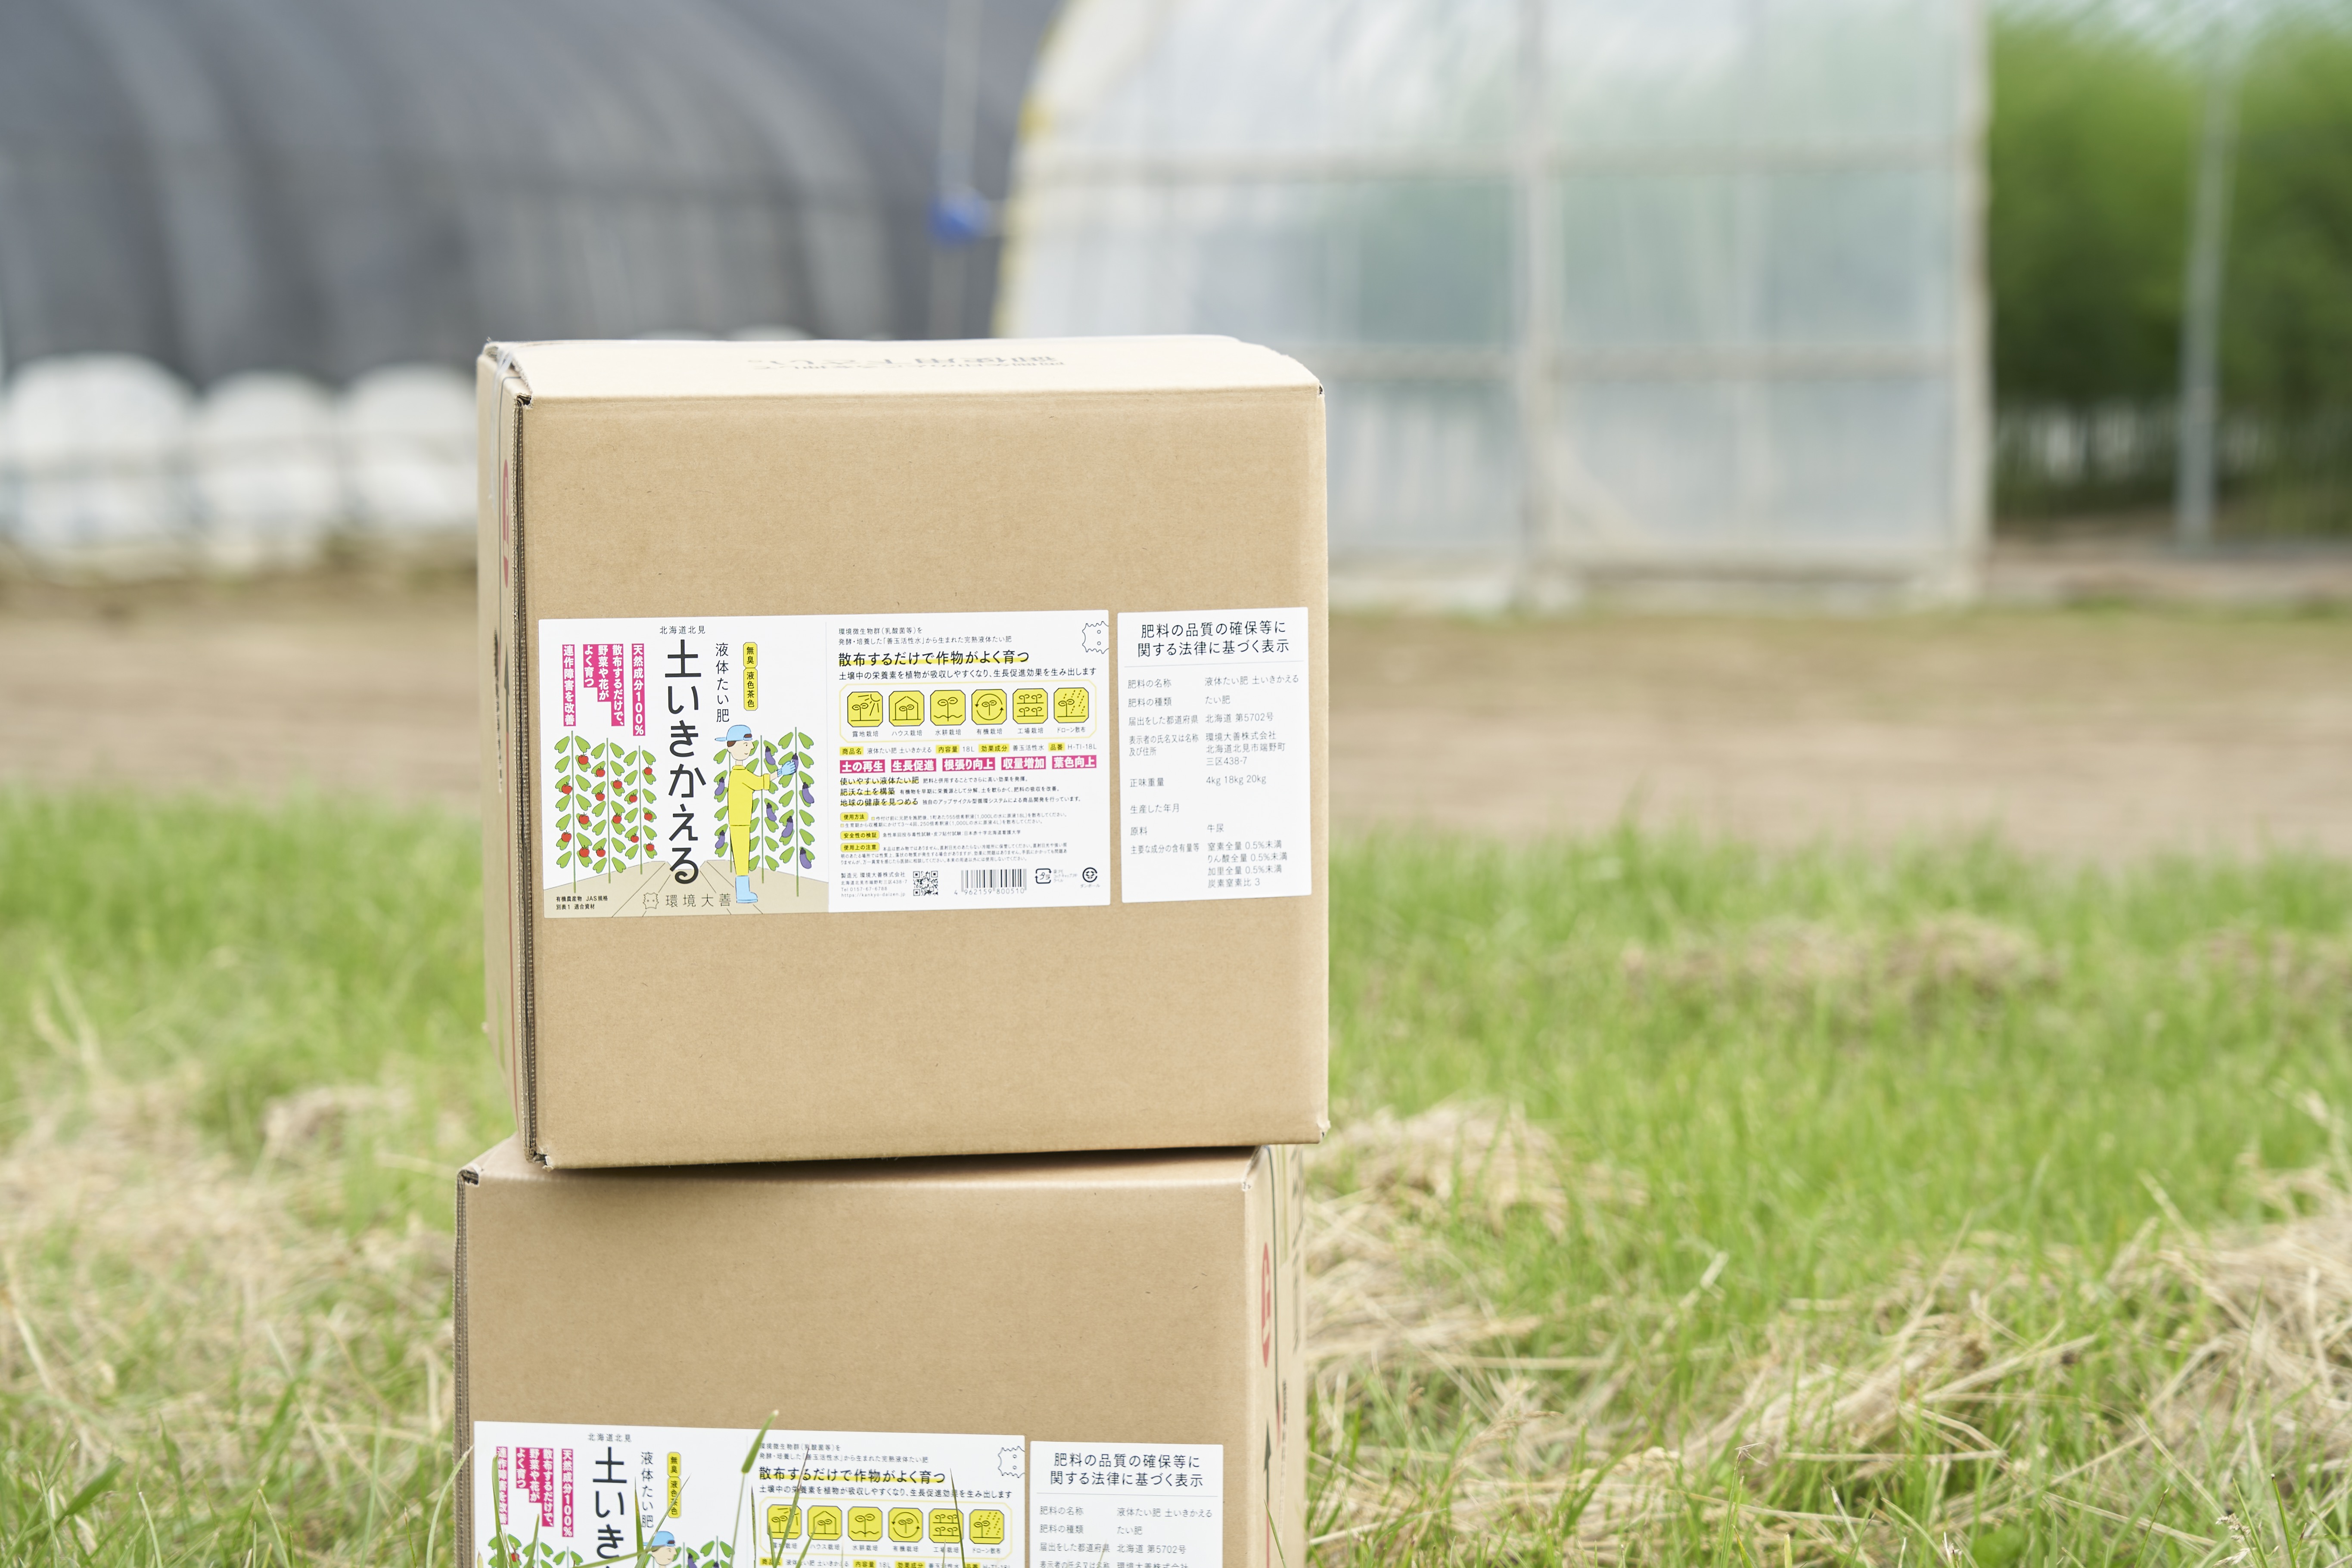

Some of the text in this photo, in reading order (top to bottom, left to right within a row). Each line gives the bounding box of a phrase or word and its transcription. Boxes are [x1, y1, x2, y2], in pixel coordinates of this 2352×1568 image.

[659, 625, 705, 635] 北海道北見
[1141, 621, 1286, 639] 肥料の品質の確保等に
[1138, 639, 1289, 657] 関する法律に基づく表示
[747, 646, 754, 664] 無臭
[839, 650, 1029, 667] 散布するだけで作物がよく育つ
[584, 645, 594, 686] よく育つ
[598, 645, 609, 701] 野菜や花が
[563, 645, 575, 725] 連作障害を改善
[612, 645, 624, 726] 散布するだけで、
[716, 643, 729, 722] 液体たい肥
[1128, 678, 1171, 689] 肥料の名称
[1205, 675, 1299, 686] 液体たい肥 土いきかえる
[633, 645, 643, 735] 天然成分100%
[1128, 697, 1171, 707] 肥料の種類
[1205, 695, 1230, 705] たい肥
[1129, 715, 1198, 726] 届出をした都道府県
[1206, 712, 1274, 723] 北海道 第5702号
[1129, 733, 1199, 745] 表示者の氏名又は名称
[1206, 731, 1276, 742] 環境大善株式会社
[1129, 747, 1156, 757] 及び住所
[1206, 742, 1285, 754] 北海道北見市端野町
[665, 639, 706, 884] 土いきかえる
[842, 761, 883, 772] 土の再生
[892, 760, 934, 771] 生長促進
[944, 758, 993, 770] 根張り向上
[1003, 758, 1044, 769] 収量増加
[1053, 757, 1095, 768] 葉色向上
[1206, 757, 1247, 766] 三区438-7
[840, 776, 919, 785] 使いやすい液体たい肥
[1130, 778, 1164, 788] 正味重量
[1206, 775, 1266, 786] 4kg 18kg 20kg
[840, 787, 895, 796] 肥沃な土を構築
[840, 798, 918, 807] 地球の健康を見つめる
[1131, 804, 1179, 814] 生産した年月
[1131, 826, 1147, 836] 原料
[1207, 823, 1224, 833] 牛尿
[1131, 843, 1199, 854] 主要な成分の含有量等
[1208, 840, 1282, 851] 窒素全量 0.5%未満
[1208, 852, 1287, 863] りん酸全量 0.5%未満
[1208, 865, 1282, 876] 加里全量 0.5%未満
[1208, 879, 1251, 888] 炭素窒素比
[666, 893, 731, 907] 環境大善
[588, 1433, 631, 1442] 北海道北見
[1054, 1452, 1200, 1469] 肥料の品質の確保等に
[517, 1447, 526, 1488] よく育つ
[529, 1448, 540, 1502] 野菜や花が
[759, 1466, 945, 1484] 散布するだけで作物がよく育つ
[1050, 1471, 1203, 1487] 関する法律に基づく表示
[543, 1449, 553, 1526] 散布するだけで、
[641, 1451, 653, 1528] 液体たい肥
[562, 1450, 572, 1537] 天然成分100%
[593, 1447, 627, 1568] 土いき
[1039, 1506, 1084, 1516] 肥料の名称
[1117, 1507, 1212, 1518] 液体たい肥 土いきかえる
[1039, 1524, 1084, 1534] 肥料の種類
[1117, 1526, 1143, 1535] たい肥
[1039, 1542, 1110, 1553] 届出をした都道府県
[1117, 1544, 1187, 1554] 北海道 第5702号
